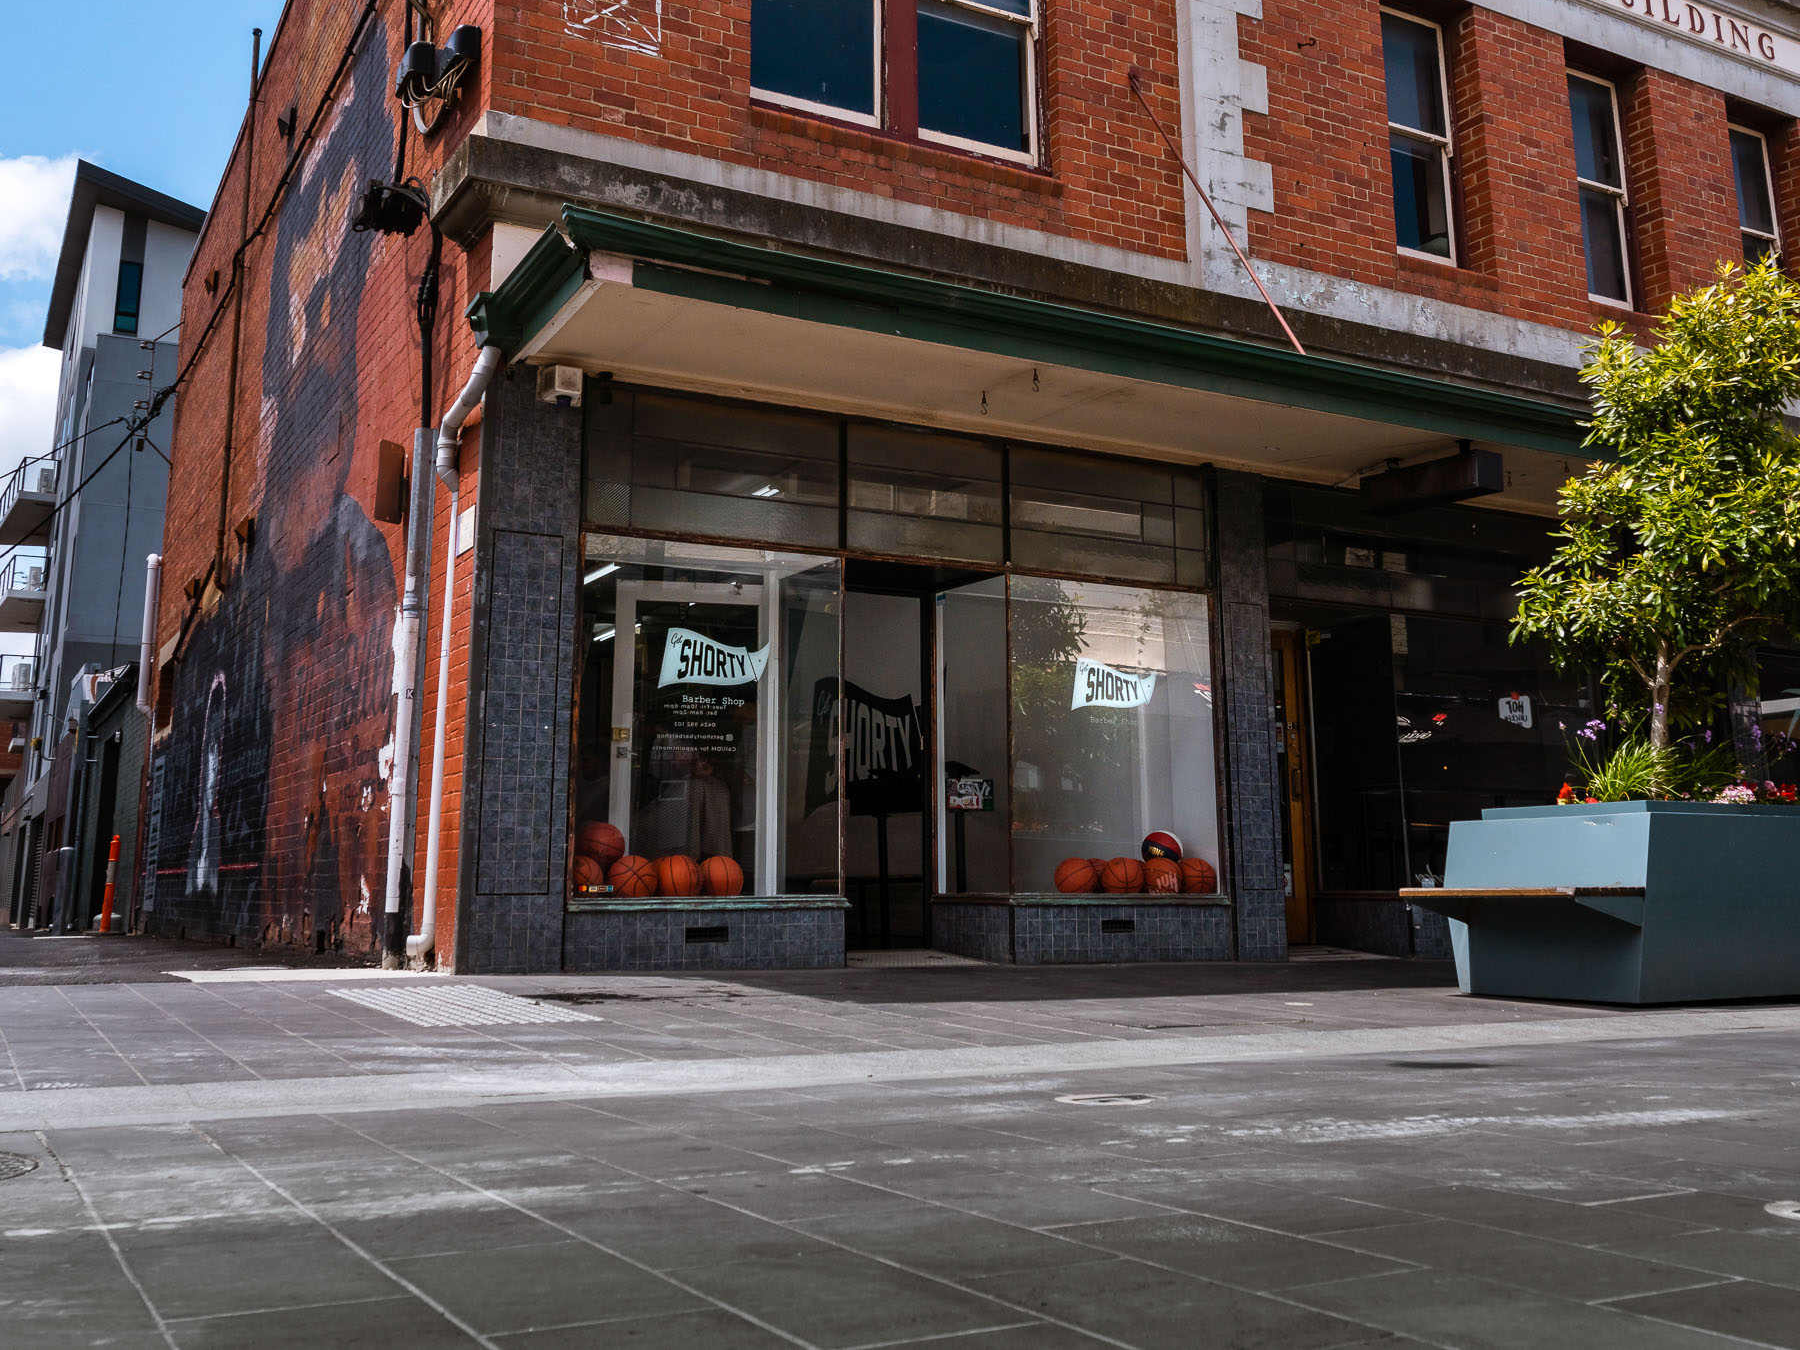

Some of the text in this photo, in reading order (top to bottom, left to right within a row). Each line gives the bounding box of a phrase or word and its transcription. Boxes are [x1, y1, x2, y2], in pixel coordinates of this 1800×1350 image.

[670, 632, 684, 649] Get
[677, 638, 746, 680] SHORTY
[1079, 661, 1089, 675] Get
[1085, 667, 1139, 703] SHORTY
[682, 694, 745, 707] Barber Shop
[824, 698, 913, 795] SHORTY
